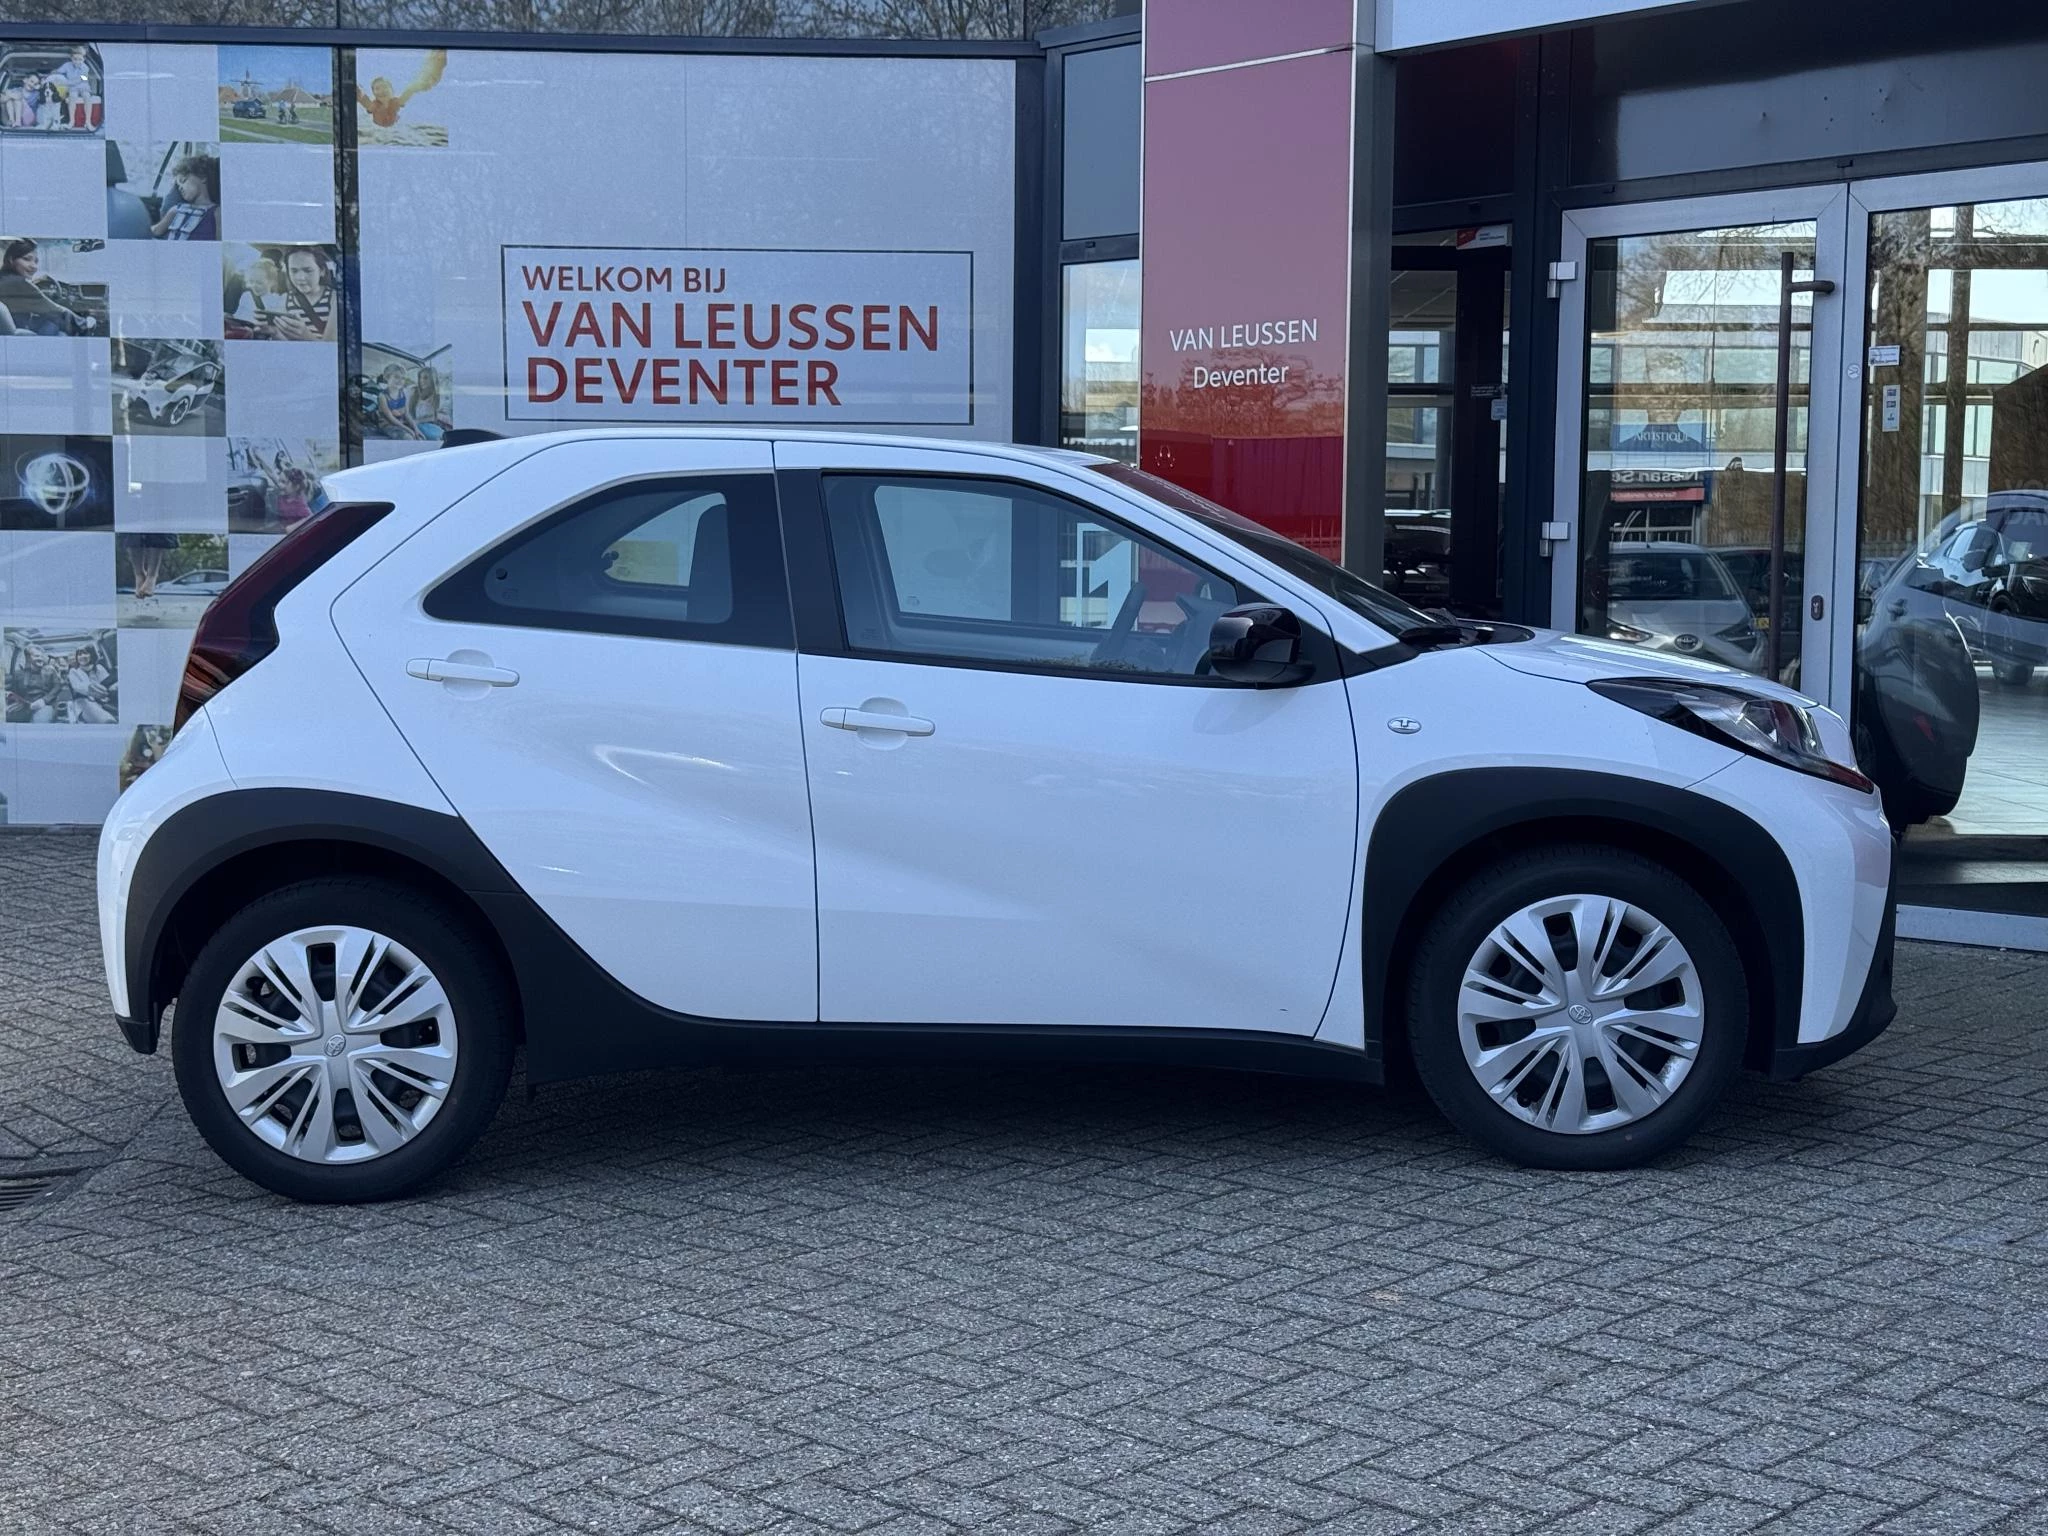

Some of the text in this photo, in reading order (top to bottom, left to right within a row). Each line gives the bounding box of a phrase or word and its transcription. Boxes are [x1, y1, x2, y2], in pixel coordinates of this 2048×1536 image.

[522, 265, 726, 293] WELKOM BIJ
[522, 301, 938, 351] VAN LEUSSEN
[1170, 318, 1317, 351] VAN LEUSSEN
[527, 357, 842, 406] DEVENTER
[1193, 364, 1289, 388] Deventer
